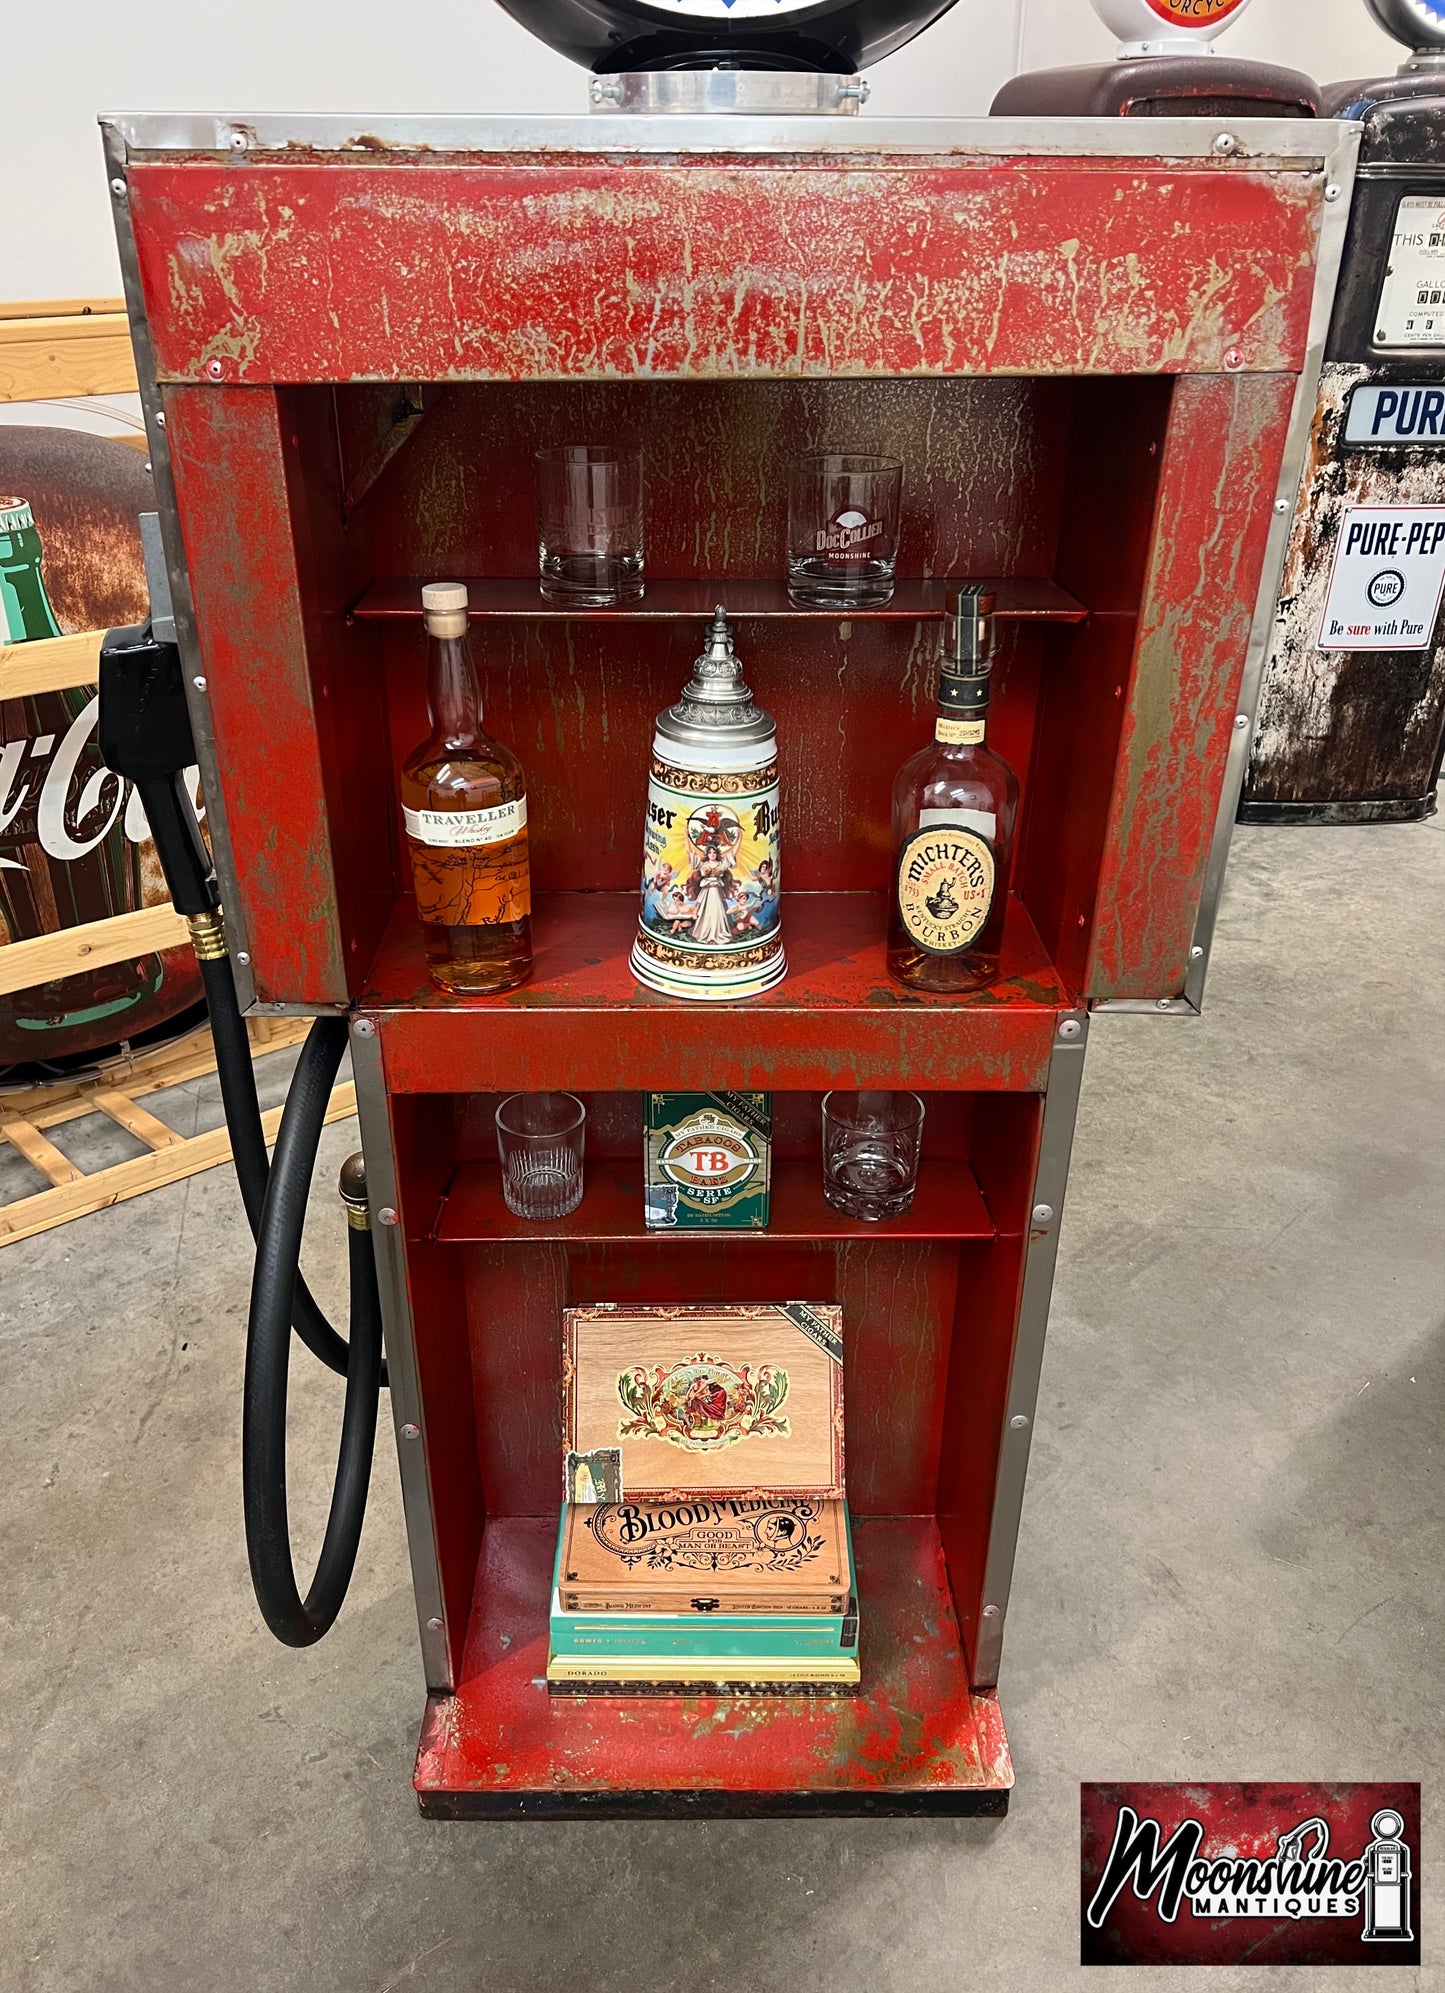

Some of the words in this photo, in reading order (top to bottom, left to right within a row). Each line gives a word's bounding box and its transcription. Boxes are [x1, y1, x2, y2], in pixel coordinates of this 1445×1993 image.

[1394, 233, 1424, 246] THIS
[1345, 522, 1445, 556] PURE-PEP
[1373, 583, 1398, 594] PURE
[1329, 620, 1344, 635] Be
[1346, 624, 1371, 635] sure
[1374, 619, 1398, 635] with
[1400, 619, 1424, 635] Pure
[422, 804, 516, 825] TRAVELLER
[907, 843, 985, 888] MICHTER'S
[922, 861, 947, 885] SMALL
[948, 862, 969, 889] BATCH
[904, 884, 920, 898] 1753
[905, 902, 983, 942] BOURBON
[916, 905, 943, 931] KENTUCKY
[944, 908, 972, 932] STRAIGHT
[923, 938, 957, 948] WHISKEY
[726, 1091, 739, 1102] MY
[738, 1101, 767, 1125] FATHER
[726, 1101, 755, 1125] CIGARS
[675, 1136, 742, 1152] TABACOS
[689, 1151, 729, 1171] TB
[686, 1187, 733, 1198] SERIE
[703, 1196, 720, 1205] SF
[800, 1310, 812, 1321] MY
[811, 1320, 838, 1345] FATHER
[800, 1321, 828, 1346] CIGARS
[617, 1503, 710, 1545] BLOOD
[697, 1531, 734, 1540] GOOD
[679, 1542, 701, 1550] MAN
[703, 1542, 717, 1550] OR
[718, 1542, 751, 1550] BEAST
